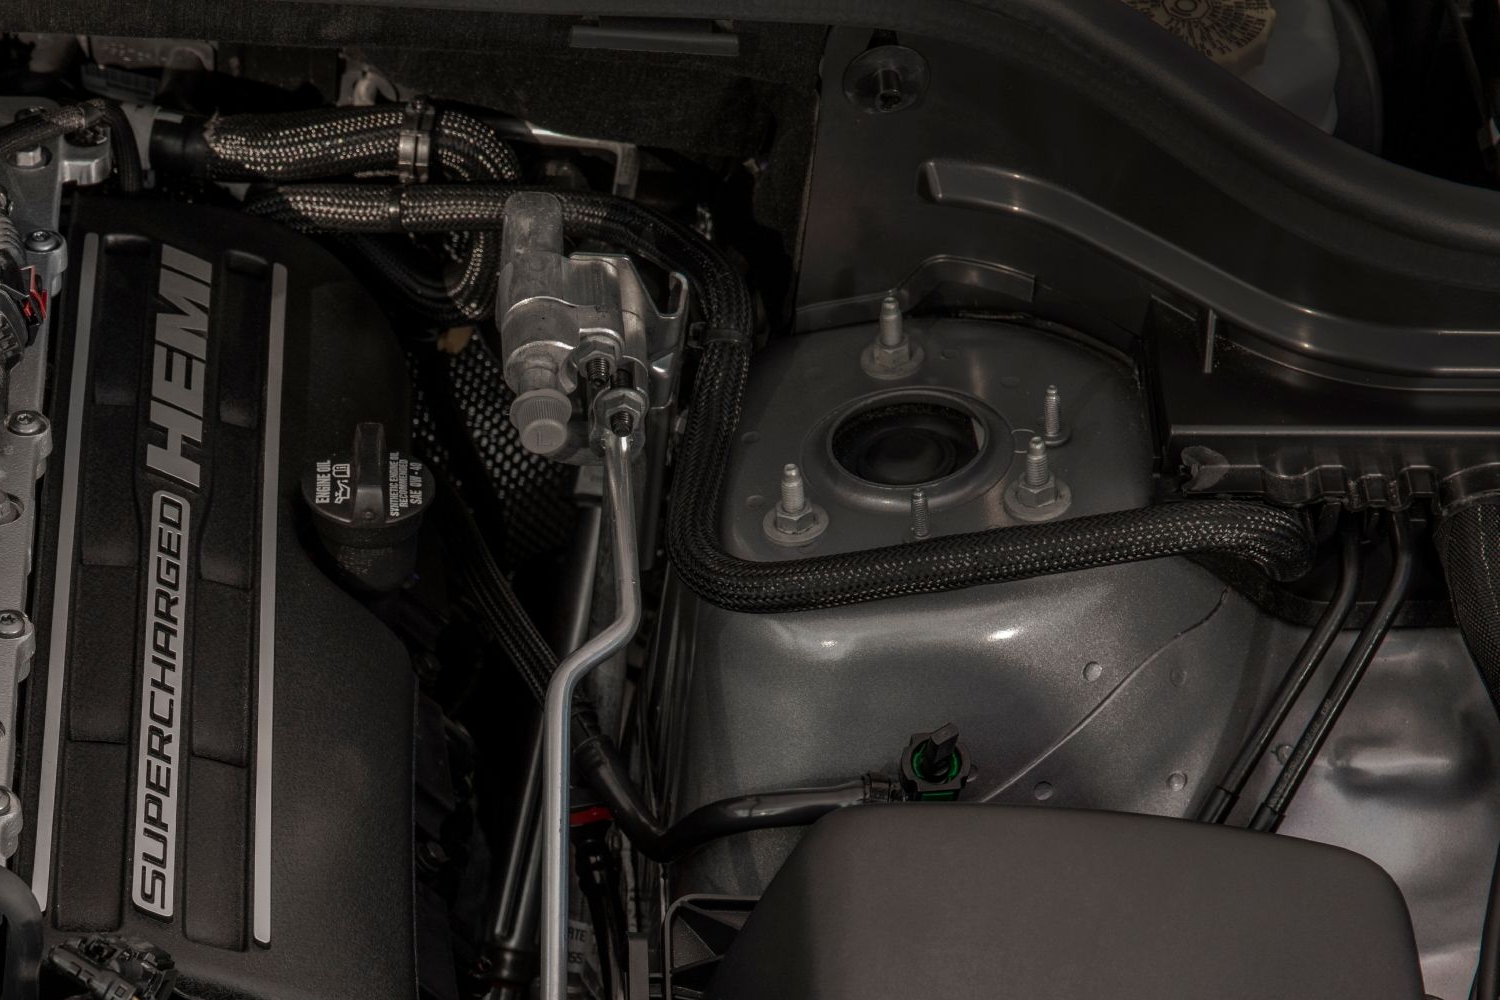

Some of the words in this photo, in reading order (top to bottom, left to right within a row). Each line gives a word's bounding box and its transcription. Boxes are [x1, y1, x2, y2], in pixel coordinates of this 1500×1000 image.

[146, 243, 212, 488] HEMI
[316, 459, 331, 473] OIL
[399, 459, 409, 508] RECOMMENDED
[315, 473, 331, 504] ENGINE
[388, 482, 400, 517] SYNTHETIC
[409, 489, 422, 505] SAE
[141, 495, 183, 910] SUPERCHARGED
